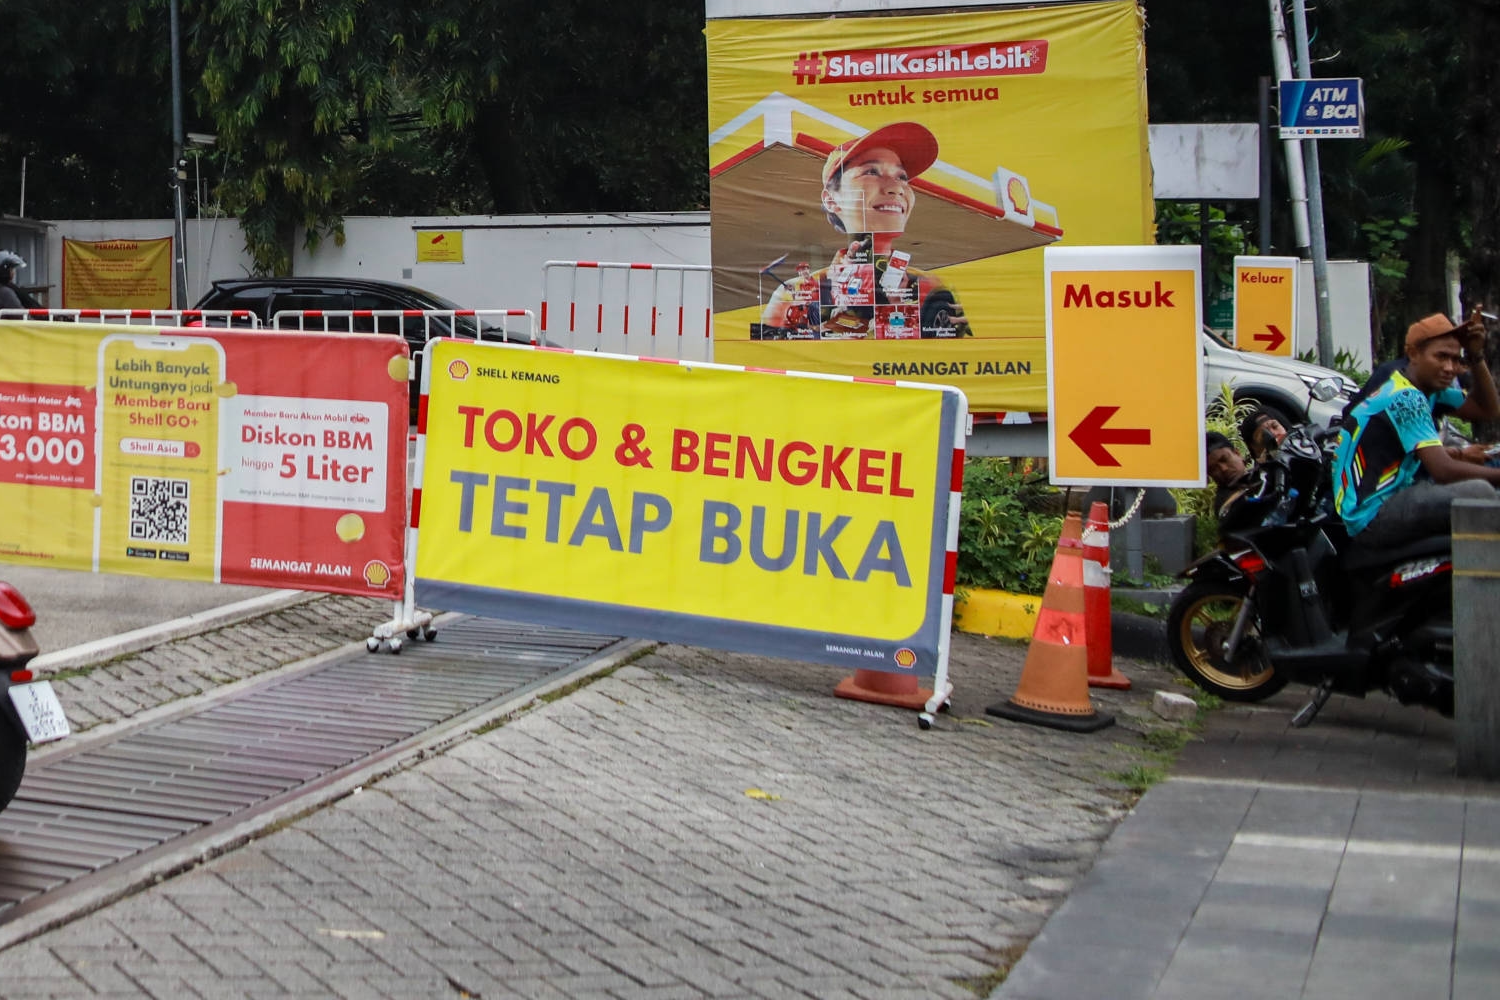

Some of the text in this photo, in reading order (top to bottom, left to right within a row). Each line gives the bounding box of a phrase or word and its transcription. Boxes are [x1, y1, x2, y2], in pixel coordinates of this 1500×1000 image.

[849, 85, 999, 106] untuk semua
[1309, 87, 1349, 103] ATM
[1322, 104, 1357, 119] BCA
[1241, 272, 1284, 284] Keluar
[1063, 281, 1176, 308] Masuk
[115, 358, 211, 378] Lebih Banyak
[476, 367, 561, 384] SHELL KEMANG
[872, 360, 1032, 377] SEMANGAT JALAN
[109, 375, 213, 397] Untungnya jadi
[114, 393, 211, 411] Member Baru
[38, 412, 86, 434] BBM
[129, 412, 199, 428] Shell GO+
[243, 409, 348, 422] Member Baru Akun Mobil
[241, 424, 373, 451] Diskon BBM
[130, 441, 179, 454] Shell Asia
[458, 405, 915, 498] TOKO & BENGKEL
[241, 456, 274, 471] hingga
[279, 453, 297, 479] 5
[306, 454, 374, 483] Liter
[450, 470, 912, 588] TETAP BUKA
[250, 557, 352, 576] SEMANGAT JALAN
[826, 644, 885, 660] SEMANGAT JALAN
